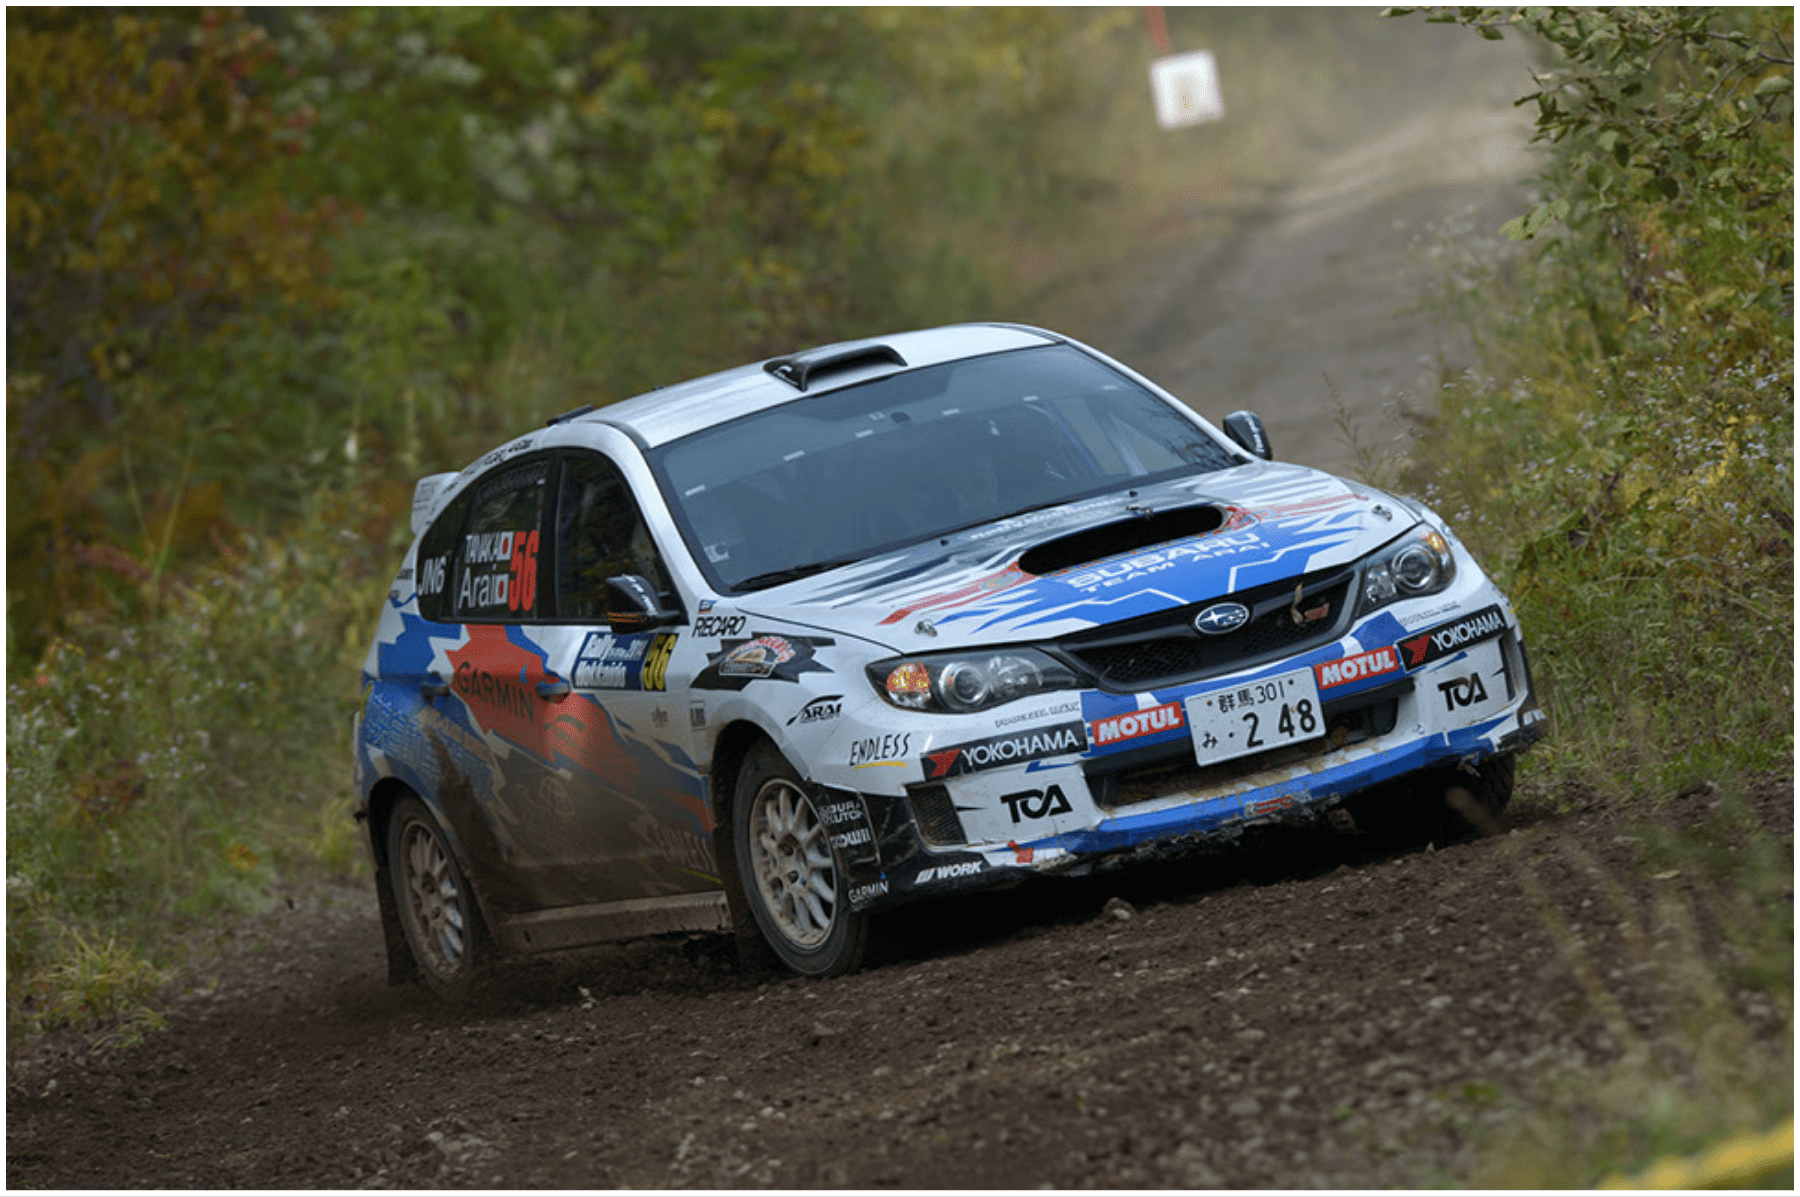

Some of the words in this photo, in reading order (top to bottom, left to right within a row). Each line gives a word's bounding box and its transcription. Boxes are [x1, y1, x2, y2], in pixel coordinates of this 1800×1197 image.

[508, 530, 539, 611] 56
[1066, 533, 1260, 588] SUBARU
[1080, 561, 1175, 593] TEAM
[458, 563, 497, 610] Arai
[691, 615, 747, 638] RECARO
[1431, 610, 1506, 652] YOKOHAMA
[642, 633, 677, 691] 56
[1321, 650, 1395, 686] MOTUL
[455, 661, 535, 724] GARMIN
[1098, 706, 1180, 743] MOTUL
[849, 732, 911, 766] ENDLESS
[961, 729, 1079, 766] YOKOHAMA
[937, 861, 983, 880] WORK
[848, 880, 889, 904] GARMIN
